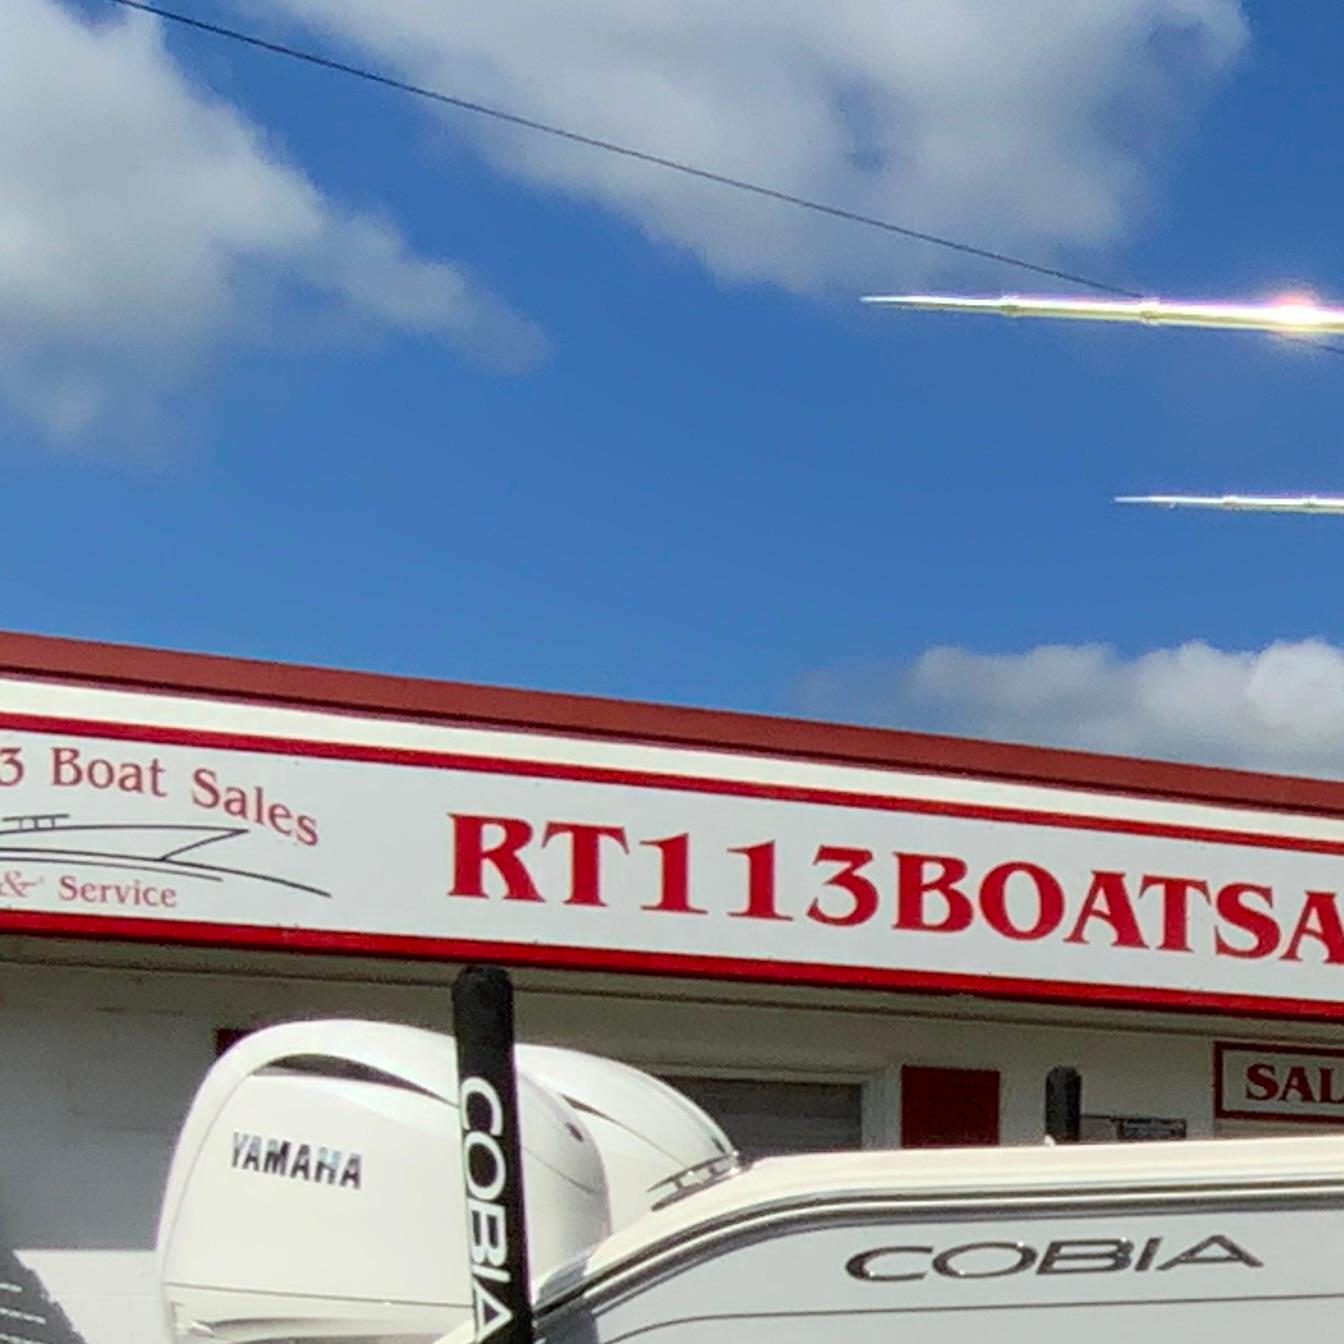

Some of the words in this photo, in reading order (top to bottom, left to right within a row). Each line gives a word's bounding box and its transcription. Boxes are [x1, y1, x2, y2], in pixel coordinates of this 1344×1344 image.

[51, 746, 168, 797] Boat
[191, 767, 319, 847] Sales
[58, 875, 178, 908] Service
[230, 1131, 364, 1191] YAMAHA
[459, 1076, 513, 1344] COBIA
[845, 1234, 1264, 1282] COBIA
